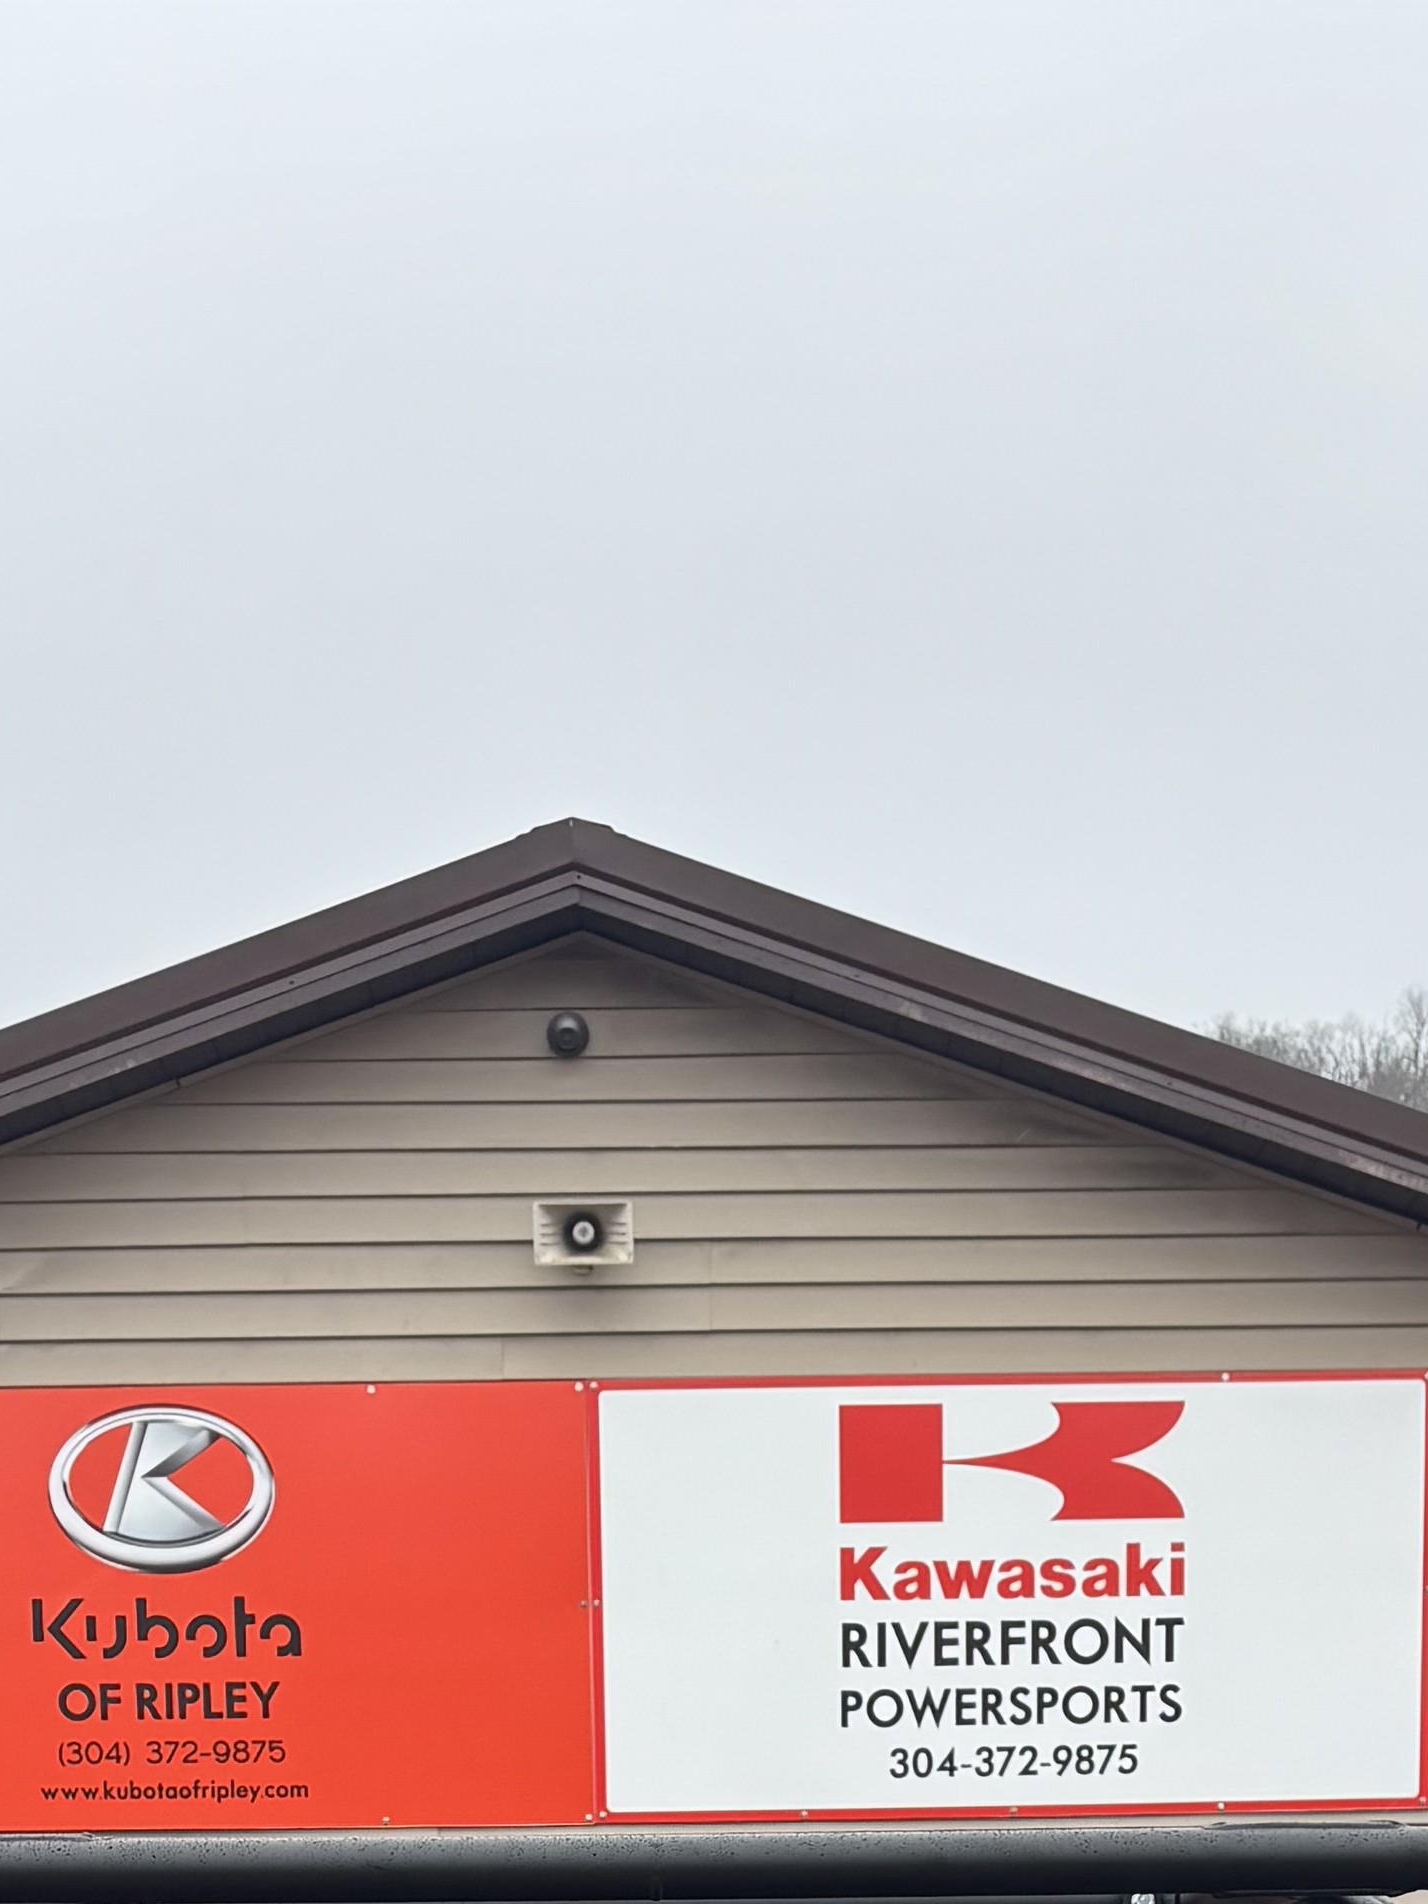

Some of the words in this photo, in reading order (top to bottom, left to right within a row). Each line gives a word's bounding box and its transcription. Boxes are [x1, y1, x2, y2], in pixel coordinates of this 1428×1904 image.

[839, 1541, 1186, 1601] Kawasaki
[31, 1596, 302, 1659] Kubota
[841, 1616, 1186, 1670] RIVERFRONT
[58, 1682, 122, 1721] OF
[135, 1681, 280, 1720] RIPLEY
[840, 1684, 1184, 1729] POWERSPORTS
[58, 1741, 130, 1767] (304)
[146, 1740, 286, 1765] 372-9875
[889, 1744, 1139, 1779] 304-372-9875
[40, 1779, 309, 1803] www.kubotaofripley.com
